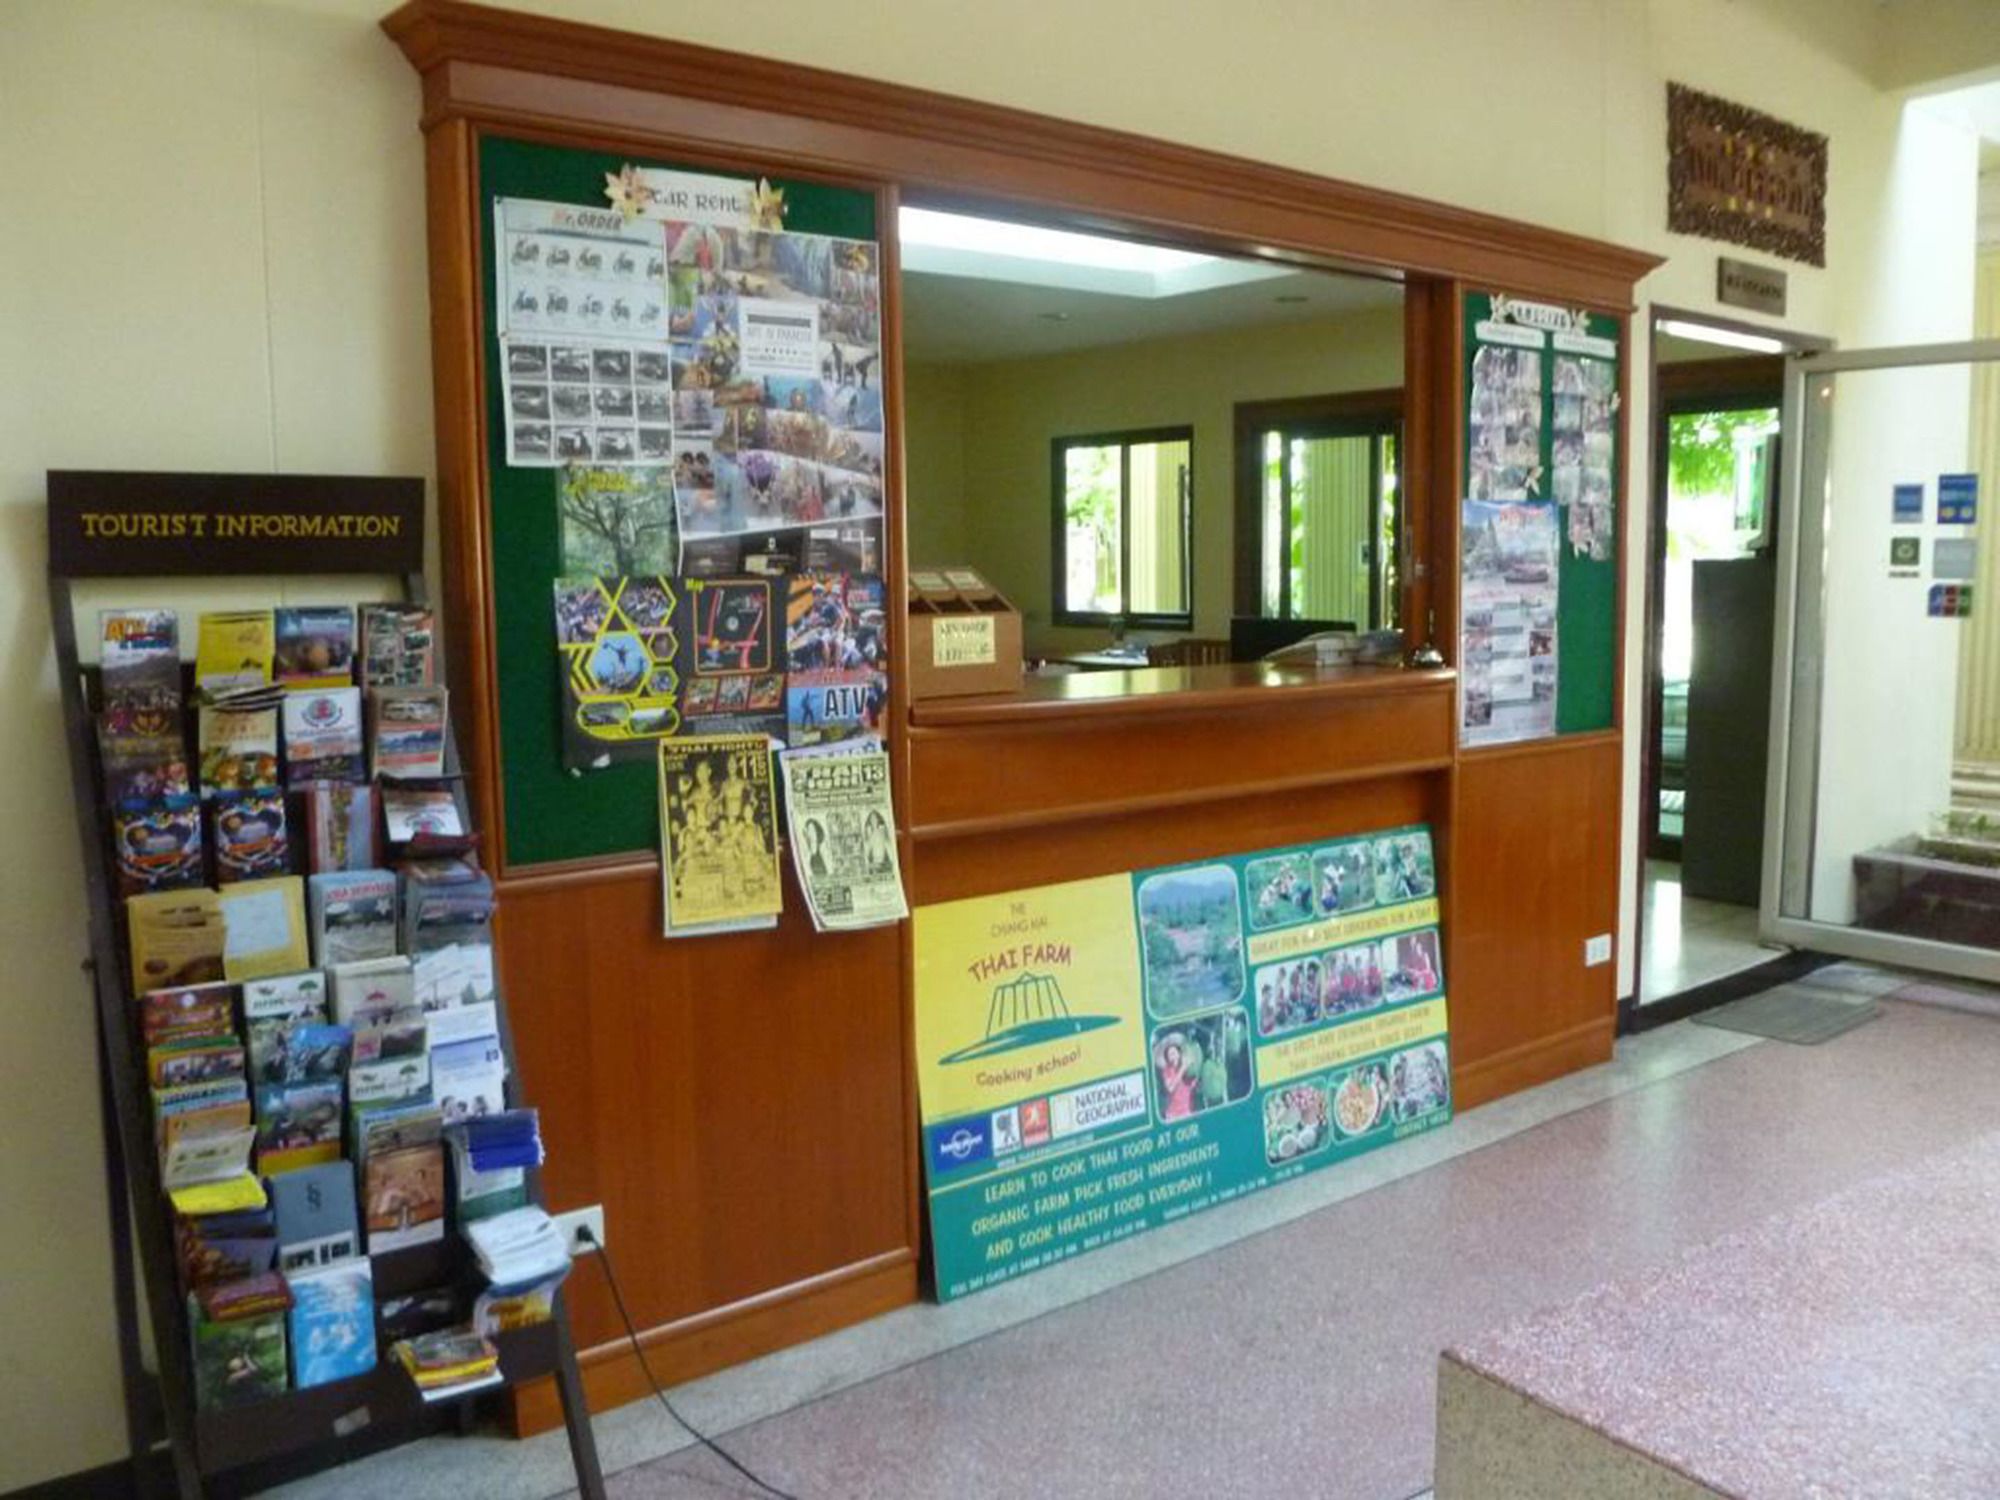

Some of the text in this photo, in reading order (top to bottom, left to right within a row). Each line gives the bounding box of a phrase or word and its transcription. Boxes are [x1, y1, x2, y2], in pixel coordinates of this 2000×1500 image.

[82, 513, 400, 538] TOURIST INFORMATION
[824, 686, 867, 719] ATV
[968, 943, 1072, 982] THAI FARM
[976, 1045, 1082, 1087] Cooking school
[1075, 1083, 1127, 1109] NATIONAL
[1075, 1094, 1143, 1126] GEOGRAPHIC
[985, 1123, 1200, 1204] LEARN TO COOK THAI FOOD AT OUR
[971, 1142, 1221, 1236] ORGANIC FARM PICK FRESH INGREDIENTS
[985, 1238, 1014, 1262] AND
[1018, 1224, 1053, 1249] COOK
[1057, 1208, 1111, 1236] HEALTHY
[1114, 1194, 1146, 1216] FOOD
[1150, 1173, 1204, 1205] EVERYDAY
